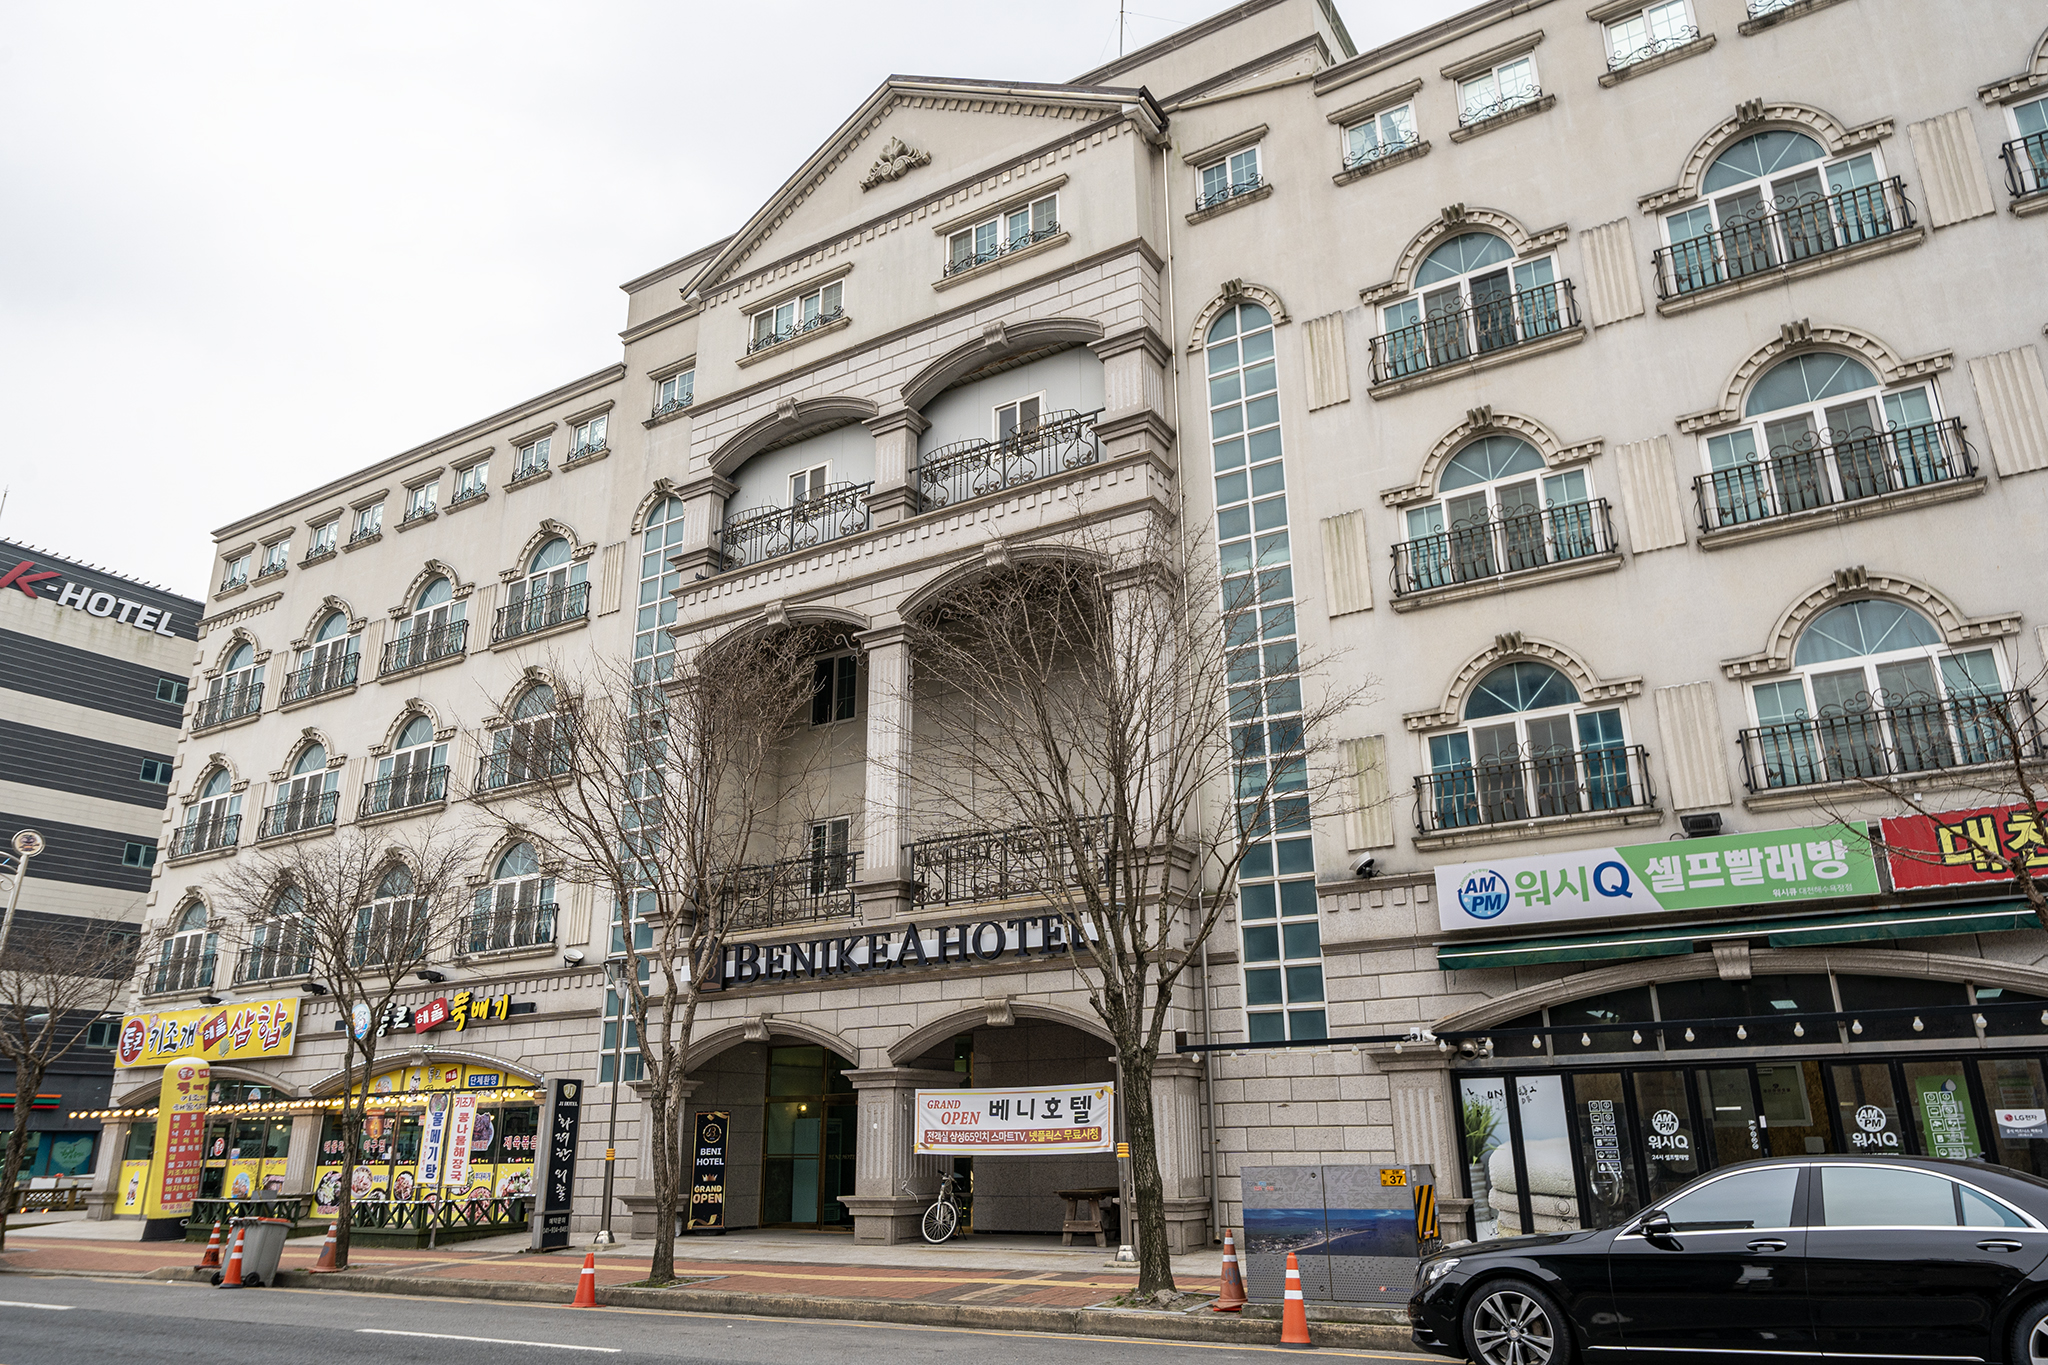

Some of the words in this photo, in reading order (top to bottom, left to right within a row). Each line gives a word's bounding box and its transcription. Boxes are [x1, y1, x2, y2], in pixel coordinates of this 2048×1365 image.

[0, 561, 175, 637] K-HOTEL
[1515, 861, 1633, 907] 워시Q
[1645, 839, 1849, 893] 셀프빨래방
[1464, 876, 1496, 894] AM
[1772, 887, 1797, 898] 워시큐
[1472, 894, 1501, 912] PM
[451, 991, 511, 1031] 뚝배기
[122, 1026, 144, 1057] 통큰
[148, 1019, 198, 1055] 키조개
[229, 1001, 288, 1051] 삼합
[470, 1075, 497, 1085] 단체환영
[455, 1097, 475, 1108] 키조개
[927, 1100, 961, 1110] GRAND
[989, 1095, 1092, 1124] 베니호텔
[1860, 1109, 1877, 1118] AM
[941, 1112, 980, 1125] OPEN
[1655, 1113, 1672, 1122] AM
[1864, 1119, 1881, 1127] PM
[1660, 1123, 1675, 1131] PM
[927, 1131, 948, 1142] 전객실
[950, 1131, 989, 1143] 삼성65인치
[991, 1131, 1027, 1142] 스마트TV,
[1029, 1130, 1062, 1142] 넷플릭스
[1064, 1128, 1098, 1140] 무료시청
[1648, 1135, 1689, 1149] 워시Q
[1852, 1132, 1898, 1147] 워시Q
[425, 1112, 443, 1179] 물메기탕
[450, 1113, 469, 1181] 콩나물해장국
[696, 1158, 724, 1166] HOTEL
[1389, 1175, 1403, 1184] 37
[694, 1185, 722, 1193] GRAND
[692, 1193, 722, 1204] OPEN
